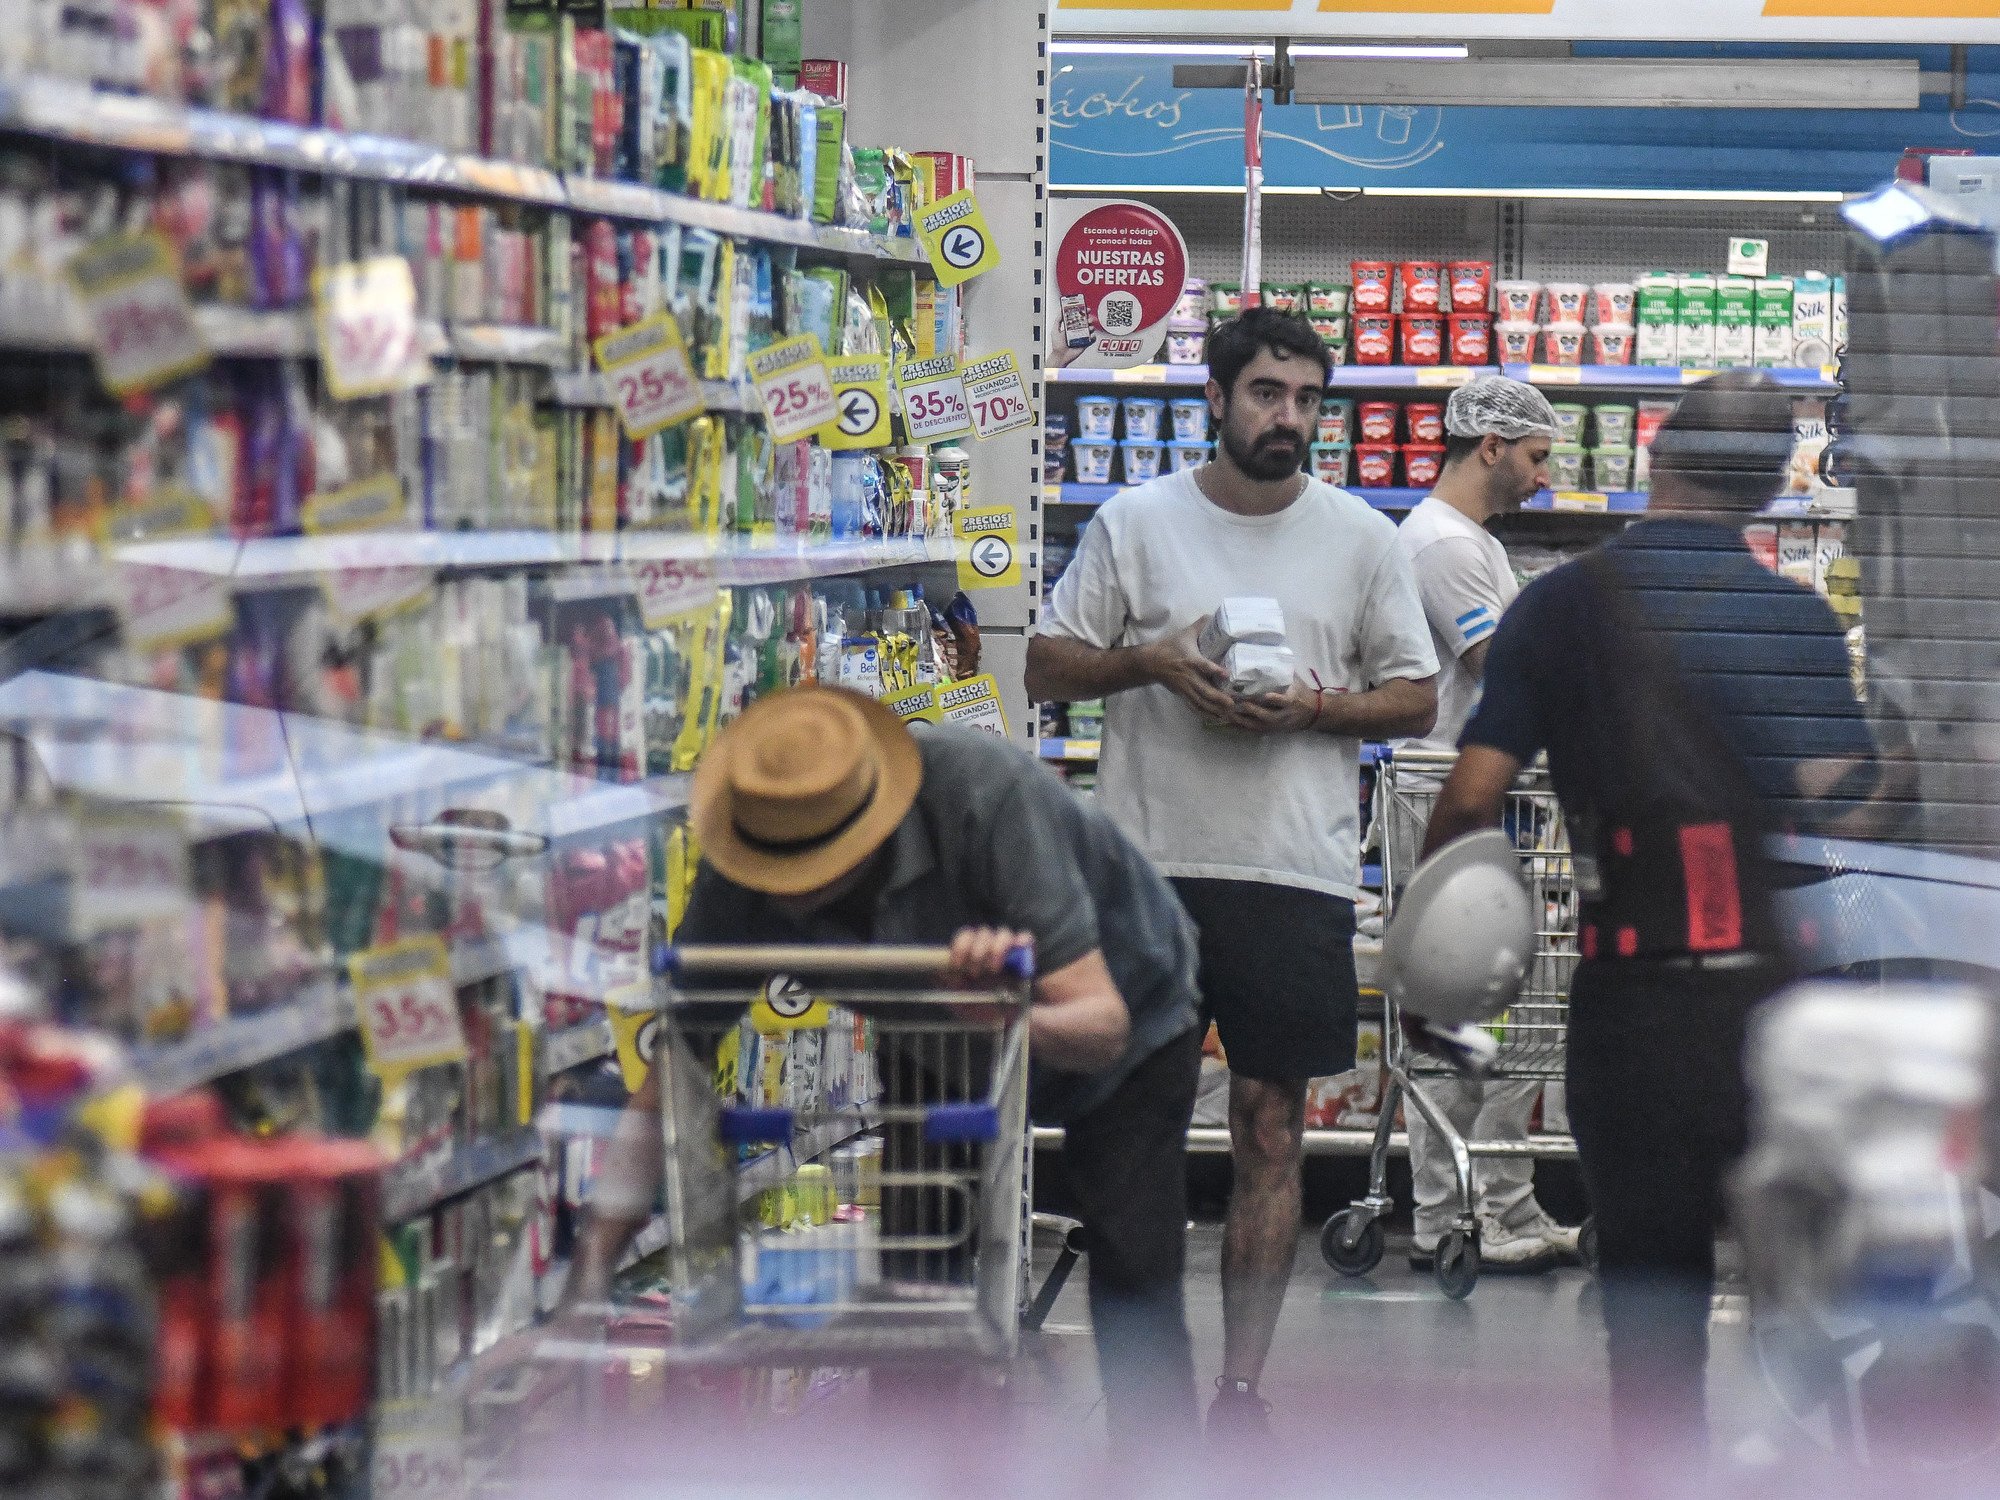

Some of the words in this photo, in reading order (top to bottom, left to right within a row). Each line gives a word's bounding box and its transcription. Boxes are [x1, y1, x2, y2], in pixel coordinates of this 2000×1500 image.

[1083, 227, 1118, 235] Escaneá
[1119, 227, 1128, 235] el
[1129, 227, 1159, 237] código
[1089, 238, 1094, 246] y
[1096, 237, 1127, 245] conocé
[1077, 250, 1165, 266] NUESTRAS
[1077, 268, 1164, 286] OFERTAS
[1794, 300, 1825, 322] Silk
[1098, 339, 1142, 351] COTO
[618, 366, 690, 411] 25%
[973, 376, 1011, 394] LLEVANDO
[1012, 374, 1018, 382] 2
[767, 380, 830, 418] 25%
[910, 390, 964, 420] 35%
[913, 422, 923, 430] DE
[925, 413, 967, 427] DESCUENTO
[973, 397, 1024, 427] 70%
[1794, 423, 1824, 443] Silk
[1781, 546, 1811, 566] Silk
[1819, 547, 1844, 566] Sil
[636, 557, 708, 597] 25%
[951, 703, 990, 719] LLEVANDO
